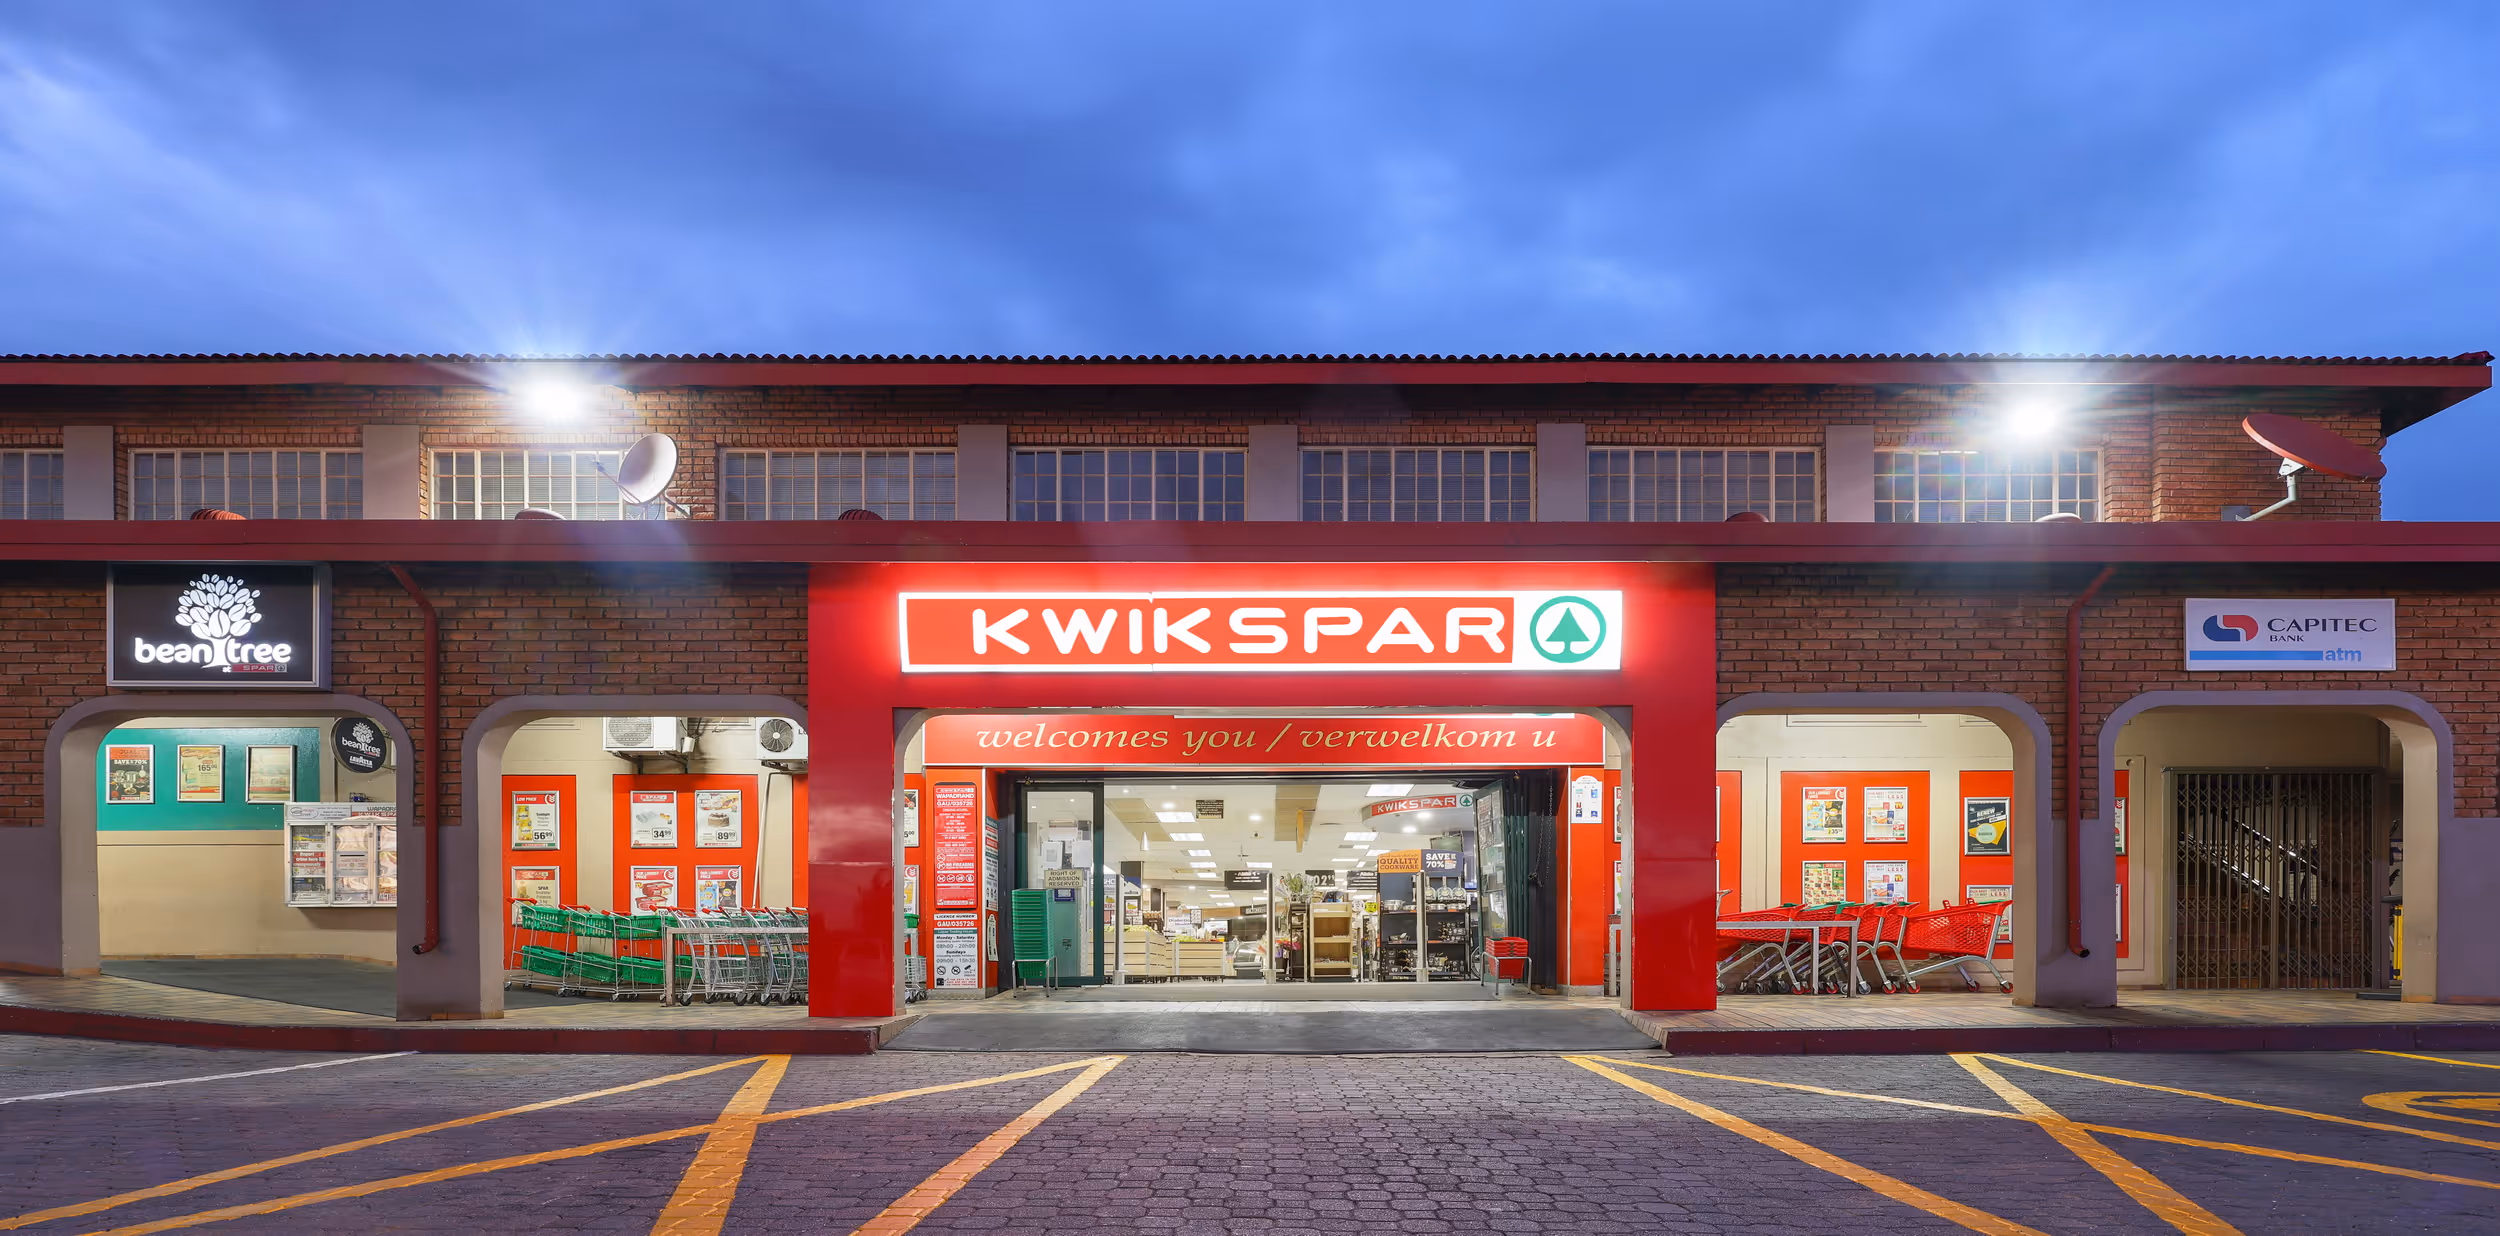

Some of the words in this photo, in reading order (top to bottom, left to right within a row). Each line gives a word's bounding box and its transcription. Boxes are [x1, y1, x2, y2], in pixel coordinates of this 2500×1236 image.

[2267, 618, 2378, 632] CAPITEC
[2325, 648, 2362, 662] atm
[976, 722, 1169, 748] welcomes
[1182, 730, 1256, 756] you
[1300, 723, 1517, 748] verwelkom
[1531, 730, 1557, 748] u
[1379, 857, 1419, 865] QUALITY
[1426, 860, 1445, 868] 70%
